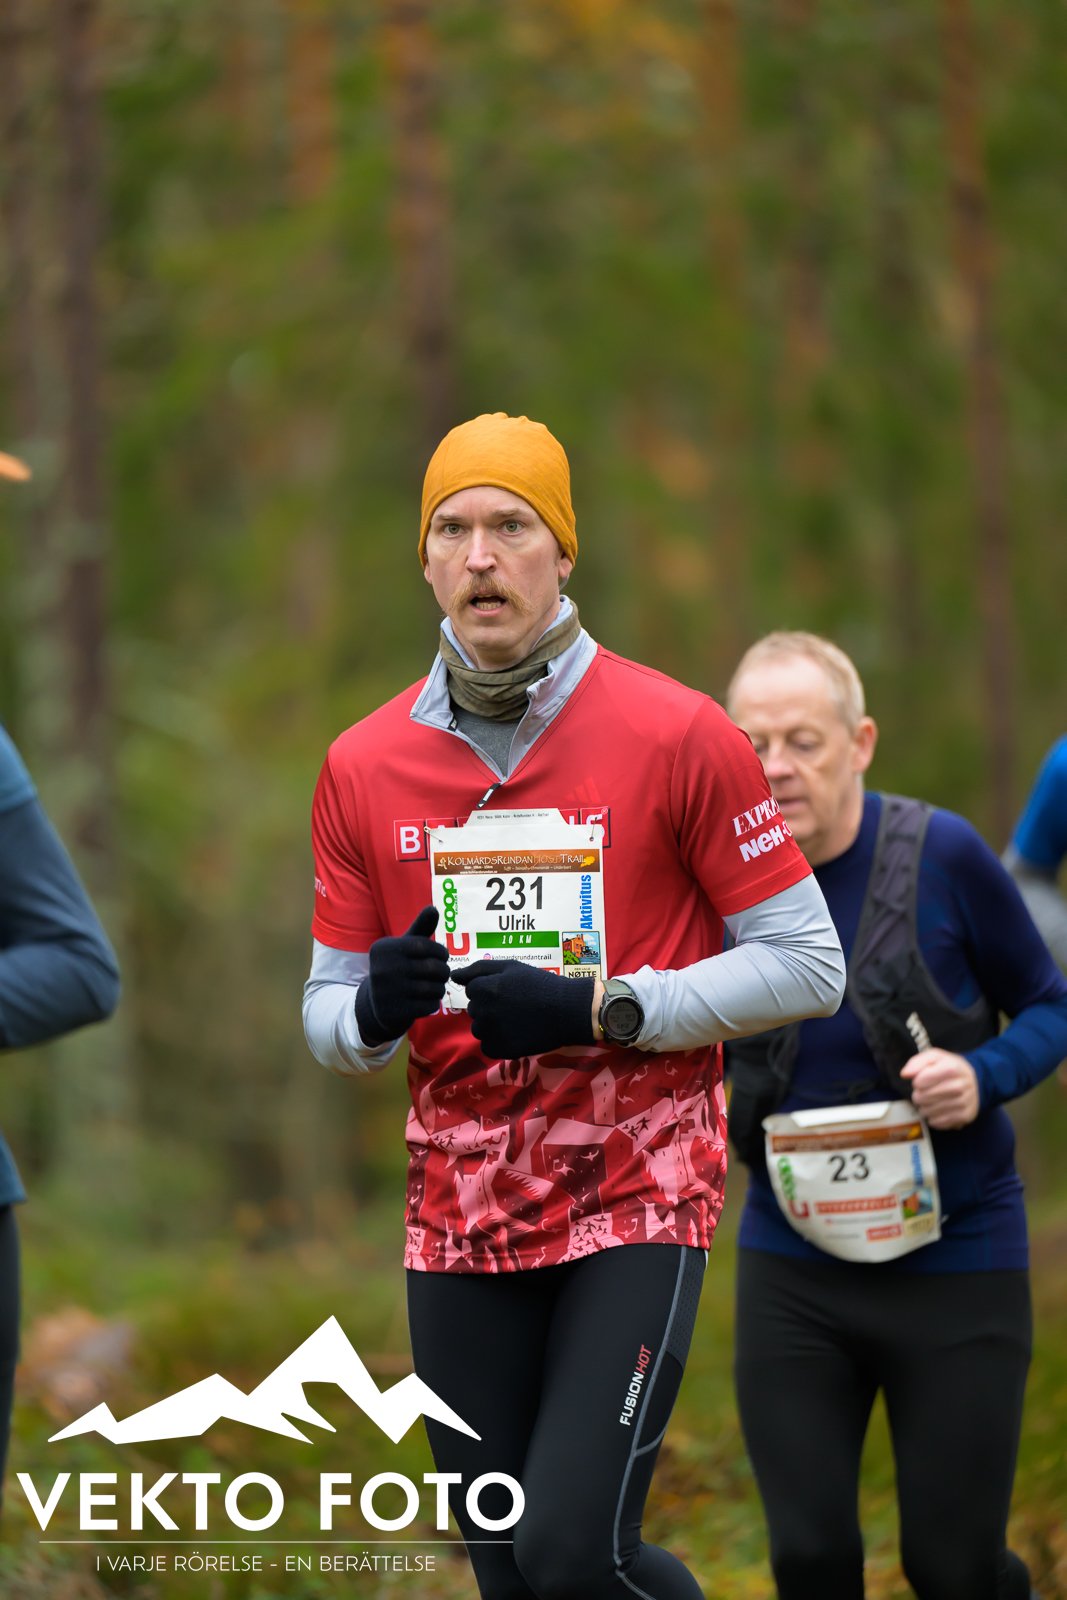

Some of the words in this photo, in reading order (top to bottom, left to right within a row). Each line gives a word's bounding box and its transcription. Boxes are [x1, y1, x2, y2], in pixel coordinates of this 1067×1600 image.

[560, 853, 586, 864] TRAIL
[485, 875, 543, 911] 231
[580, 874, 593, 930] Aktivitus
[498, 914, 536, 931] Ulrik
[502, 934, 513, 944] 10
[519, 934, 532, 944] KM
[828, 1152, 870, 1184] 23
